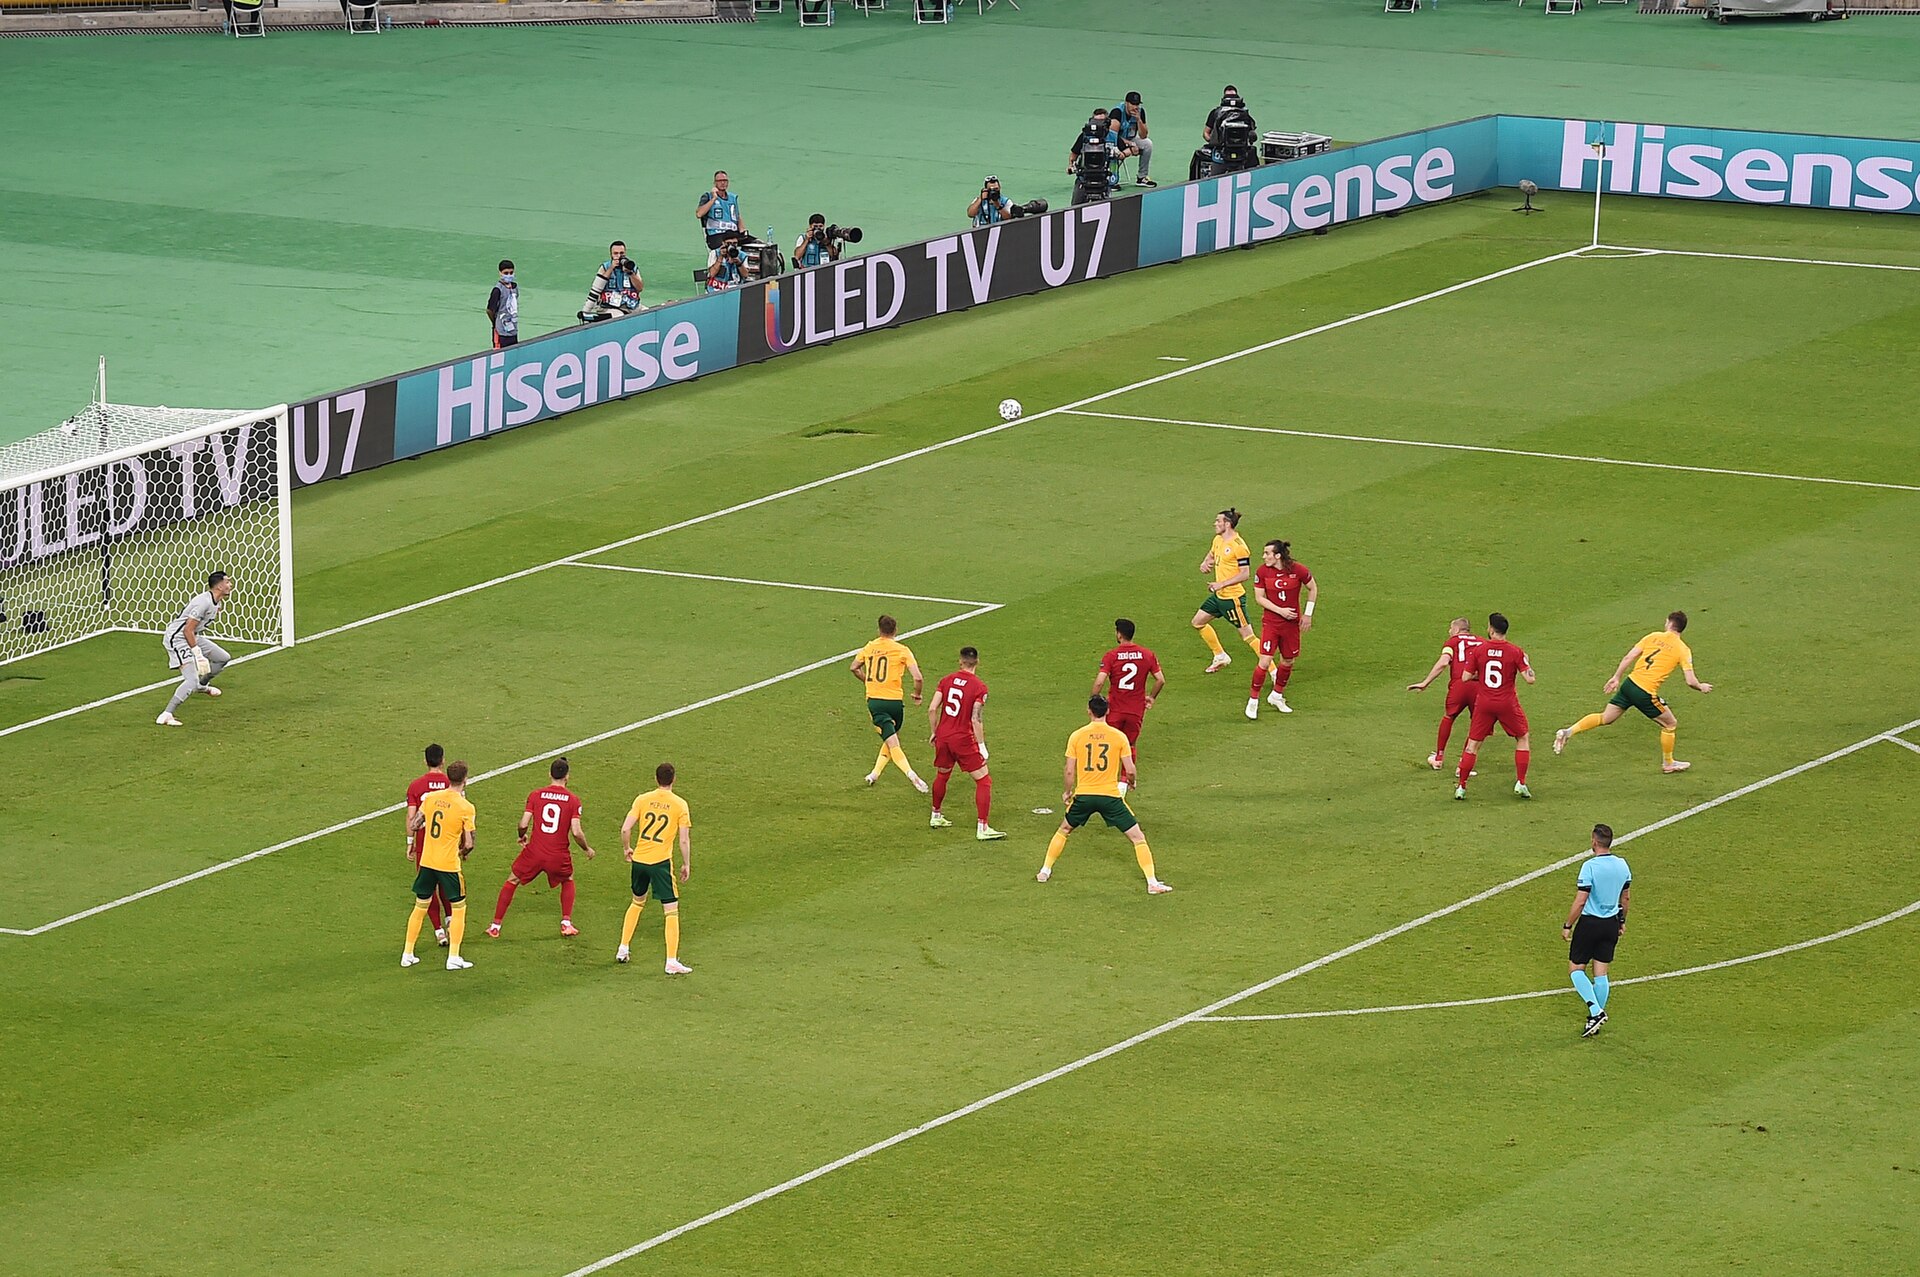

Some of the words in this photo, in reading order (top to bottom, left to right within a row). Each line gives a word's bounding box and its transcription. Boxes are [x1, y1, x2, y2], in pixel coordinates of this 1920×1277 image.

[1560, 119, 1920, 212] Hisens
[1181, 147, 1456, 258] Hisense
[764, 252, 906, 353] ULED
[925, 227, 1001, 314] TV
[1040, 202, 1112, 287] U7
[436, 321, 701, 446] Hisense
[168, 425, 251, 518] TV
[292, 390, 367, 484] U7
[1278, 590, 1287, 602] 4
[1227, 608, 1238, 621] 11
[1263, 640, 1271, 652] 4
[1645, 648, 1662, 670] 4
[867, 656, 888, 683] 10
[1118, 662, 1138, 690] 2
[1485, 660, 1503, 688] 6
[945, 687, 964, 717] 5
[1084, 743, 1109, 772] 13
[431, 810, 444, 839] 6
[541, 803, 561, 834] 9
[641, 812, 669, 843] 22
